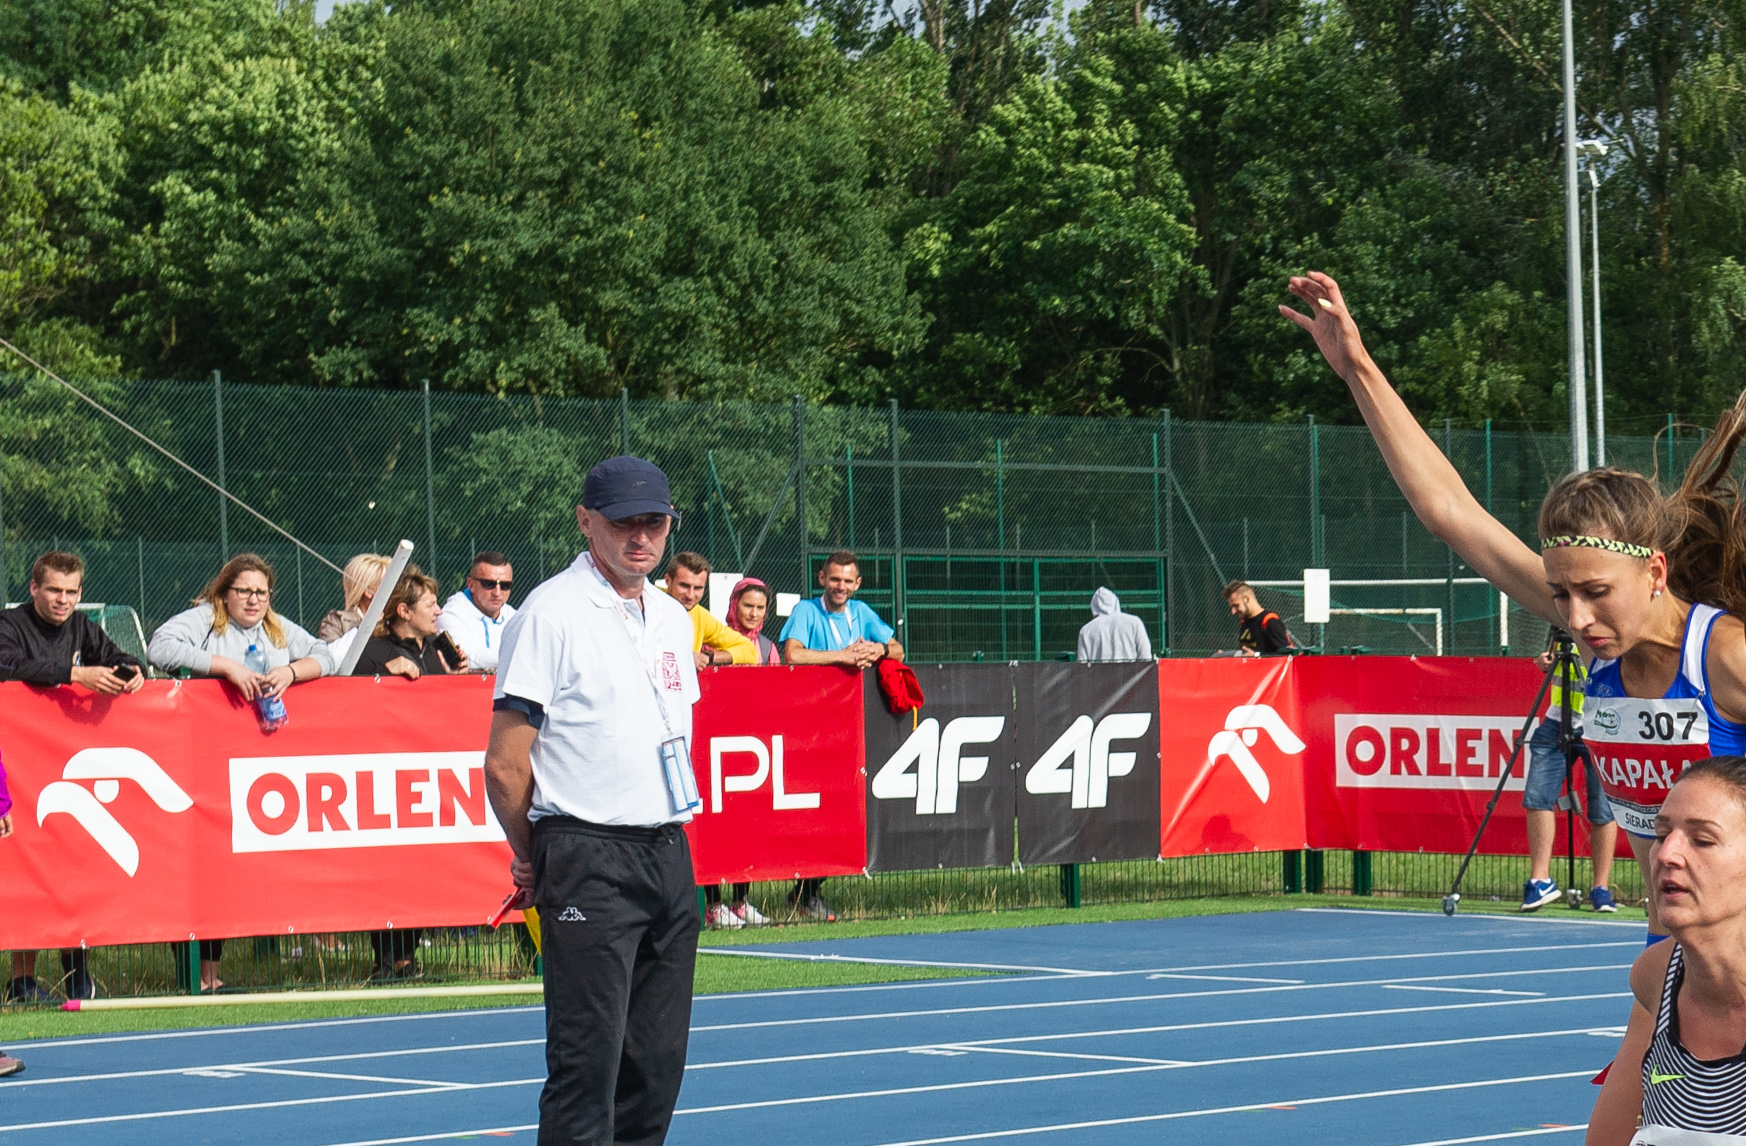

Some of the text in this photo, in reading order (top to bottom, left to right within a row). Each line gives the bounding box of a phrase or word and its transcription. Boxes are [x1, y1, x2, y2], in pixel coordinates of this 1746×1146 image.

[1345, 725, 1526, 779] ORLEN
[1638, 710, 1699, 741] 307
[872, 716, 1005, 815] 4F
[1025, 712, 1151, 810] 4F
[246, 767, 487, 836] ORLEN
[1625, 812, 1656, 830] SIERAD
